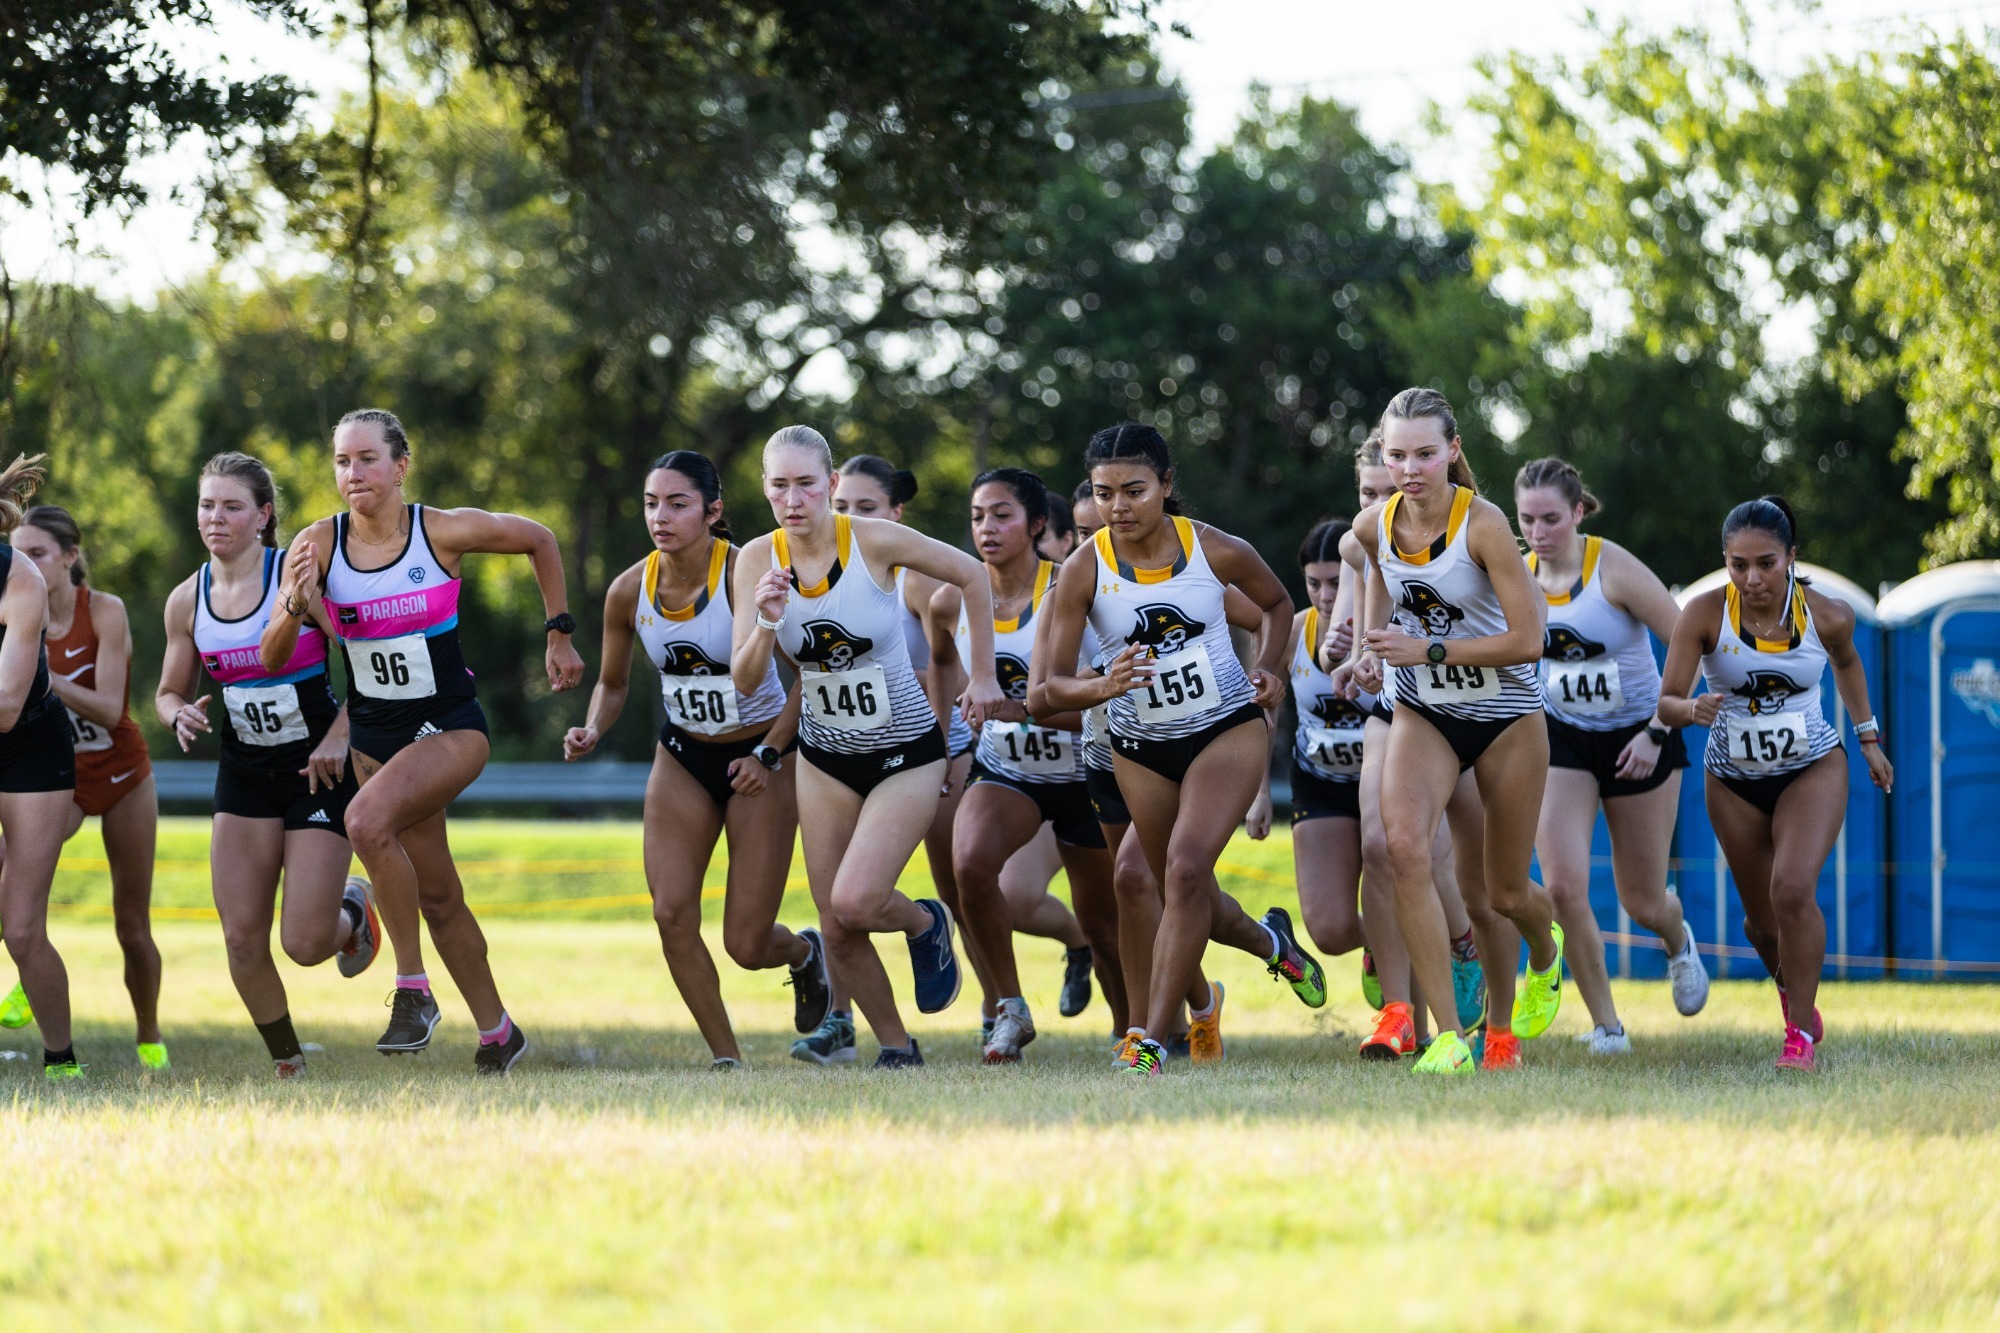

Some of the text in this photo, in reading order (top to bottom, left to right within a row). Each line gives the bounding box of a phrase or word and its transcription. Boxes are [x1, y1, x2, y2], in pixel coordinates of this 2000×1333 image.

[361, 593, 428, 622] PARAGON
[391, 612, 428, 626] TRAINING
[370, 651, 410, 686] 96
[1426, 664, 1485, 690] 149
[817, 681, 877, 717] 146
[1141, 661, 1204, 709] 155
[1559, 672, 1611, 702] 144
[243, 699, 282, 734] 95
[673, 687, 726, 724] 150
[71, 718, 97, 744] 5
[1004, 730, 1062, 762] 145
[1740, 727, 1799, 763] 152
[1317, 741, 1364, 767] 159
